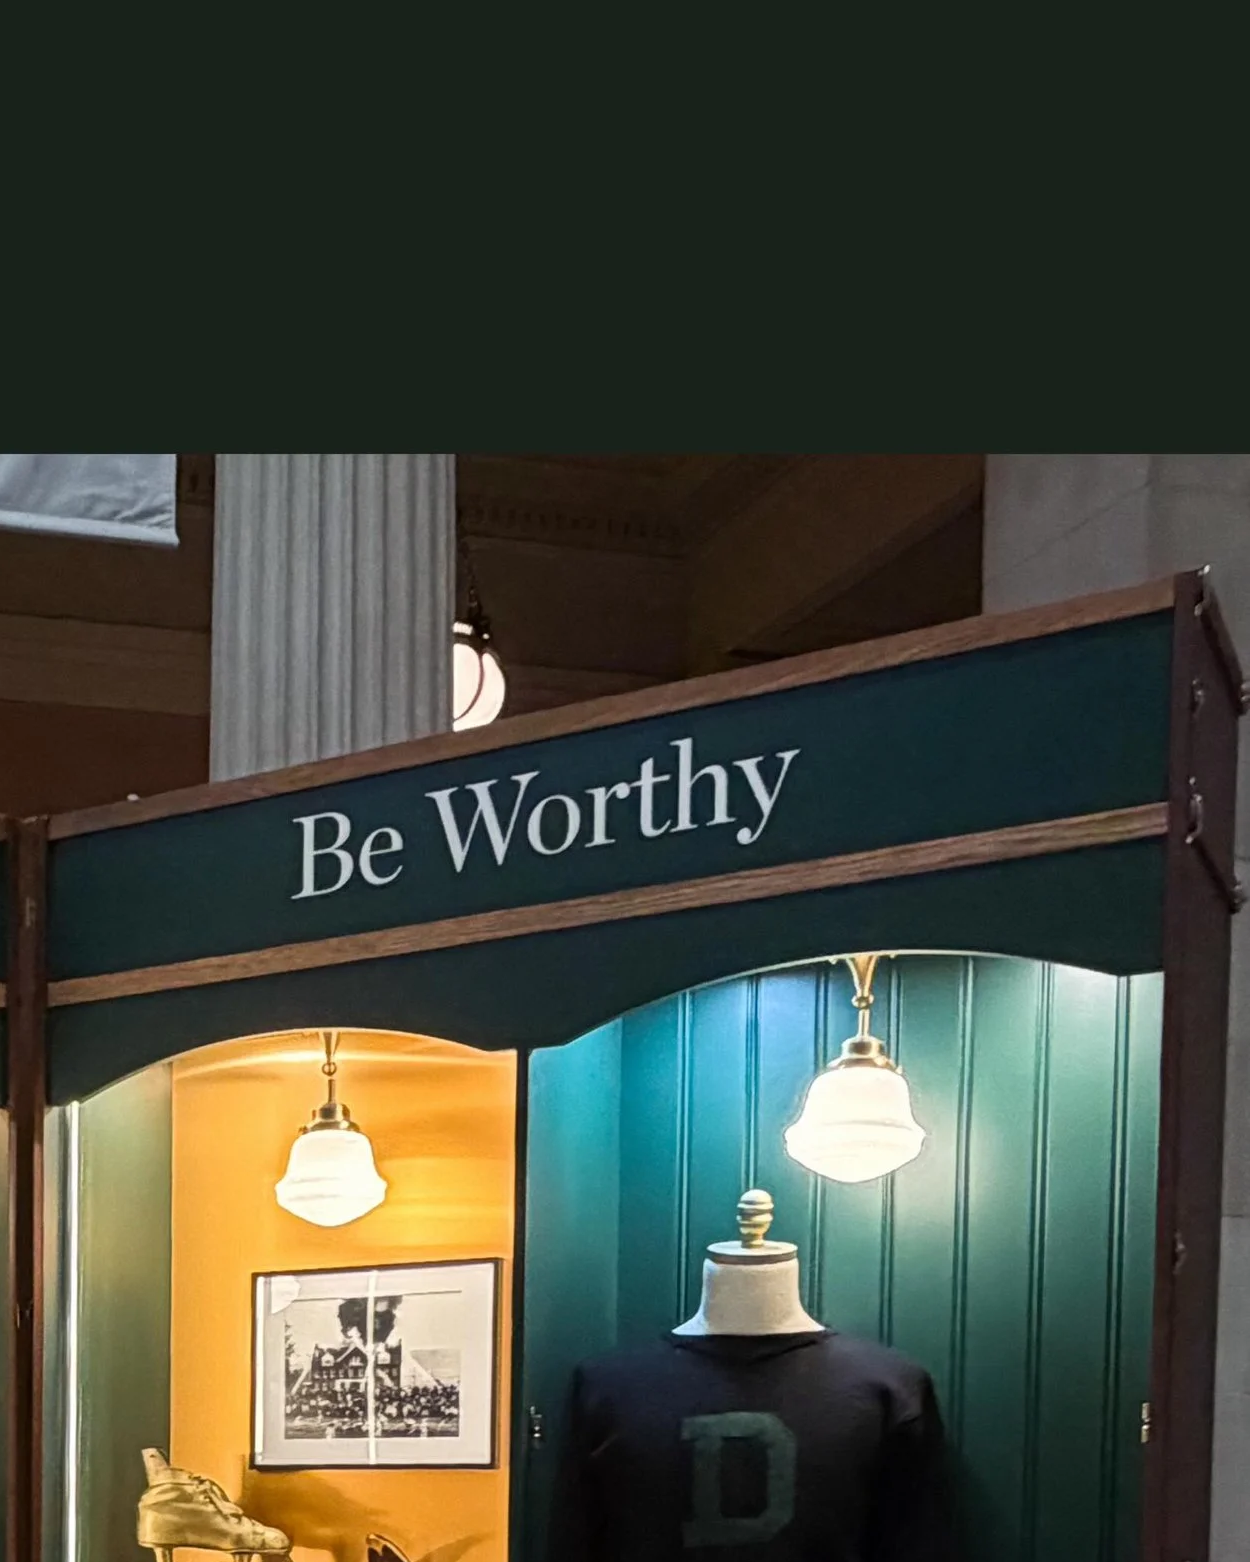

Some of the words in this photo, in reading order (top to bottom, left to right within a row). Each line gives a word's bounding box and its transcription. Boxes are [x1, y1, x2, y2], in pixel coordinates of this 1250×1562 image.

[291, 810, 404, 900] Be
[424, 737, 800, 874] Worthy
[680, 1411, 797, 1547] D
